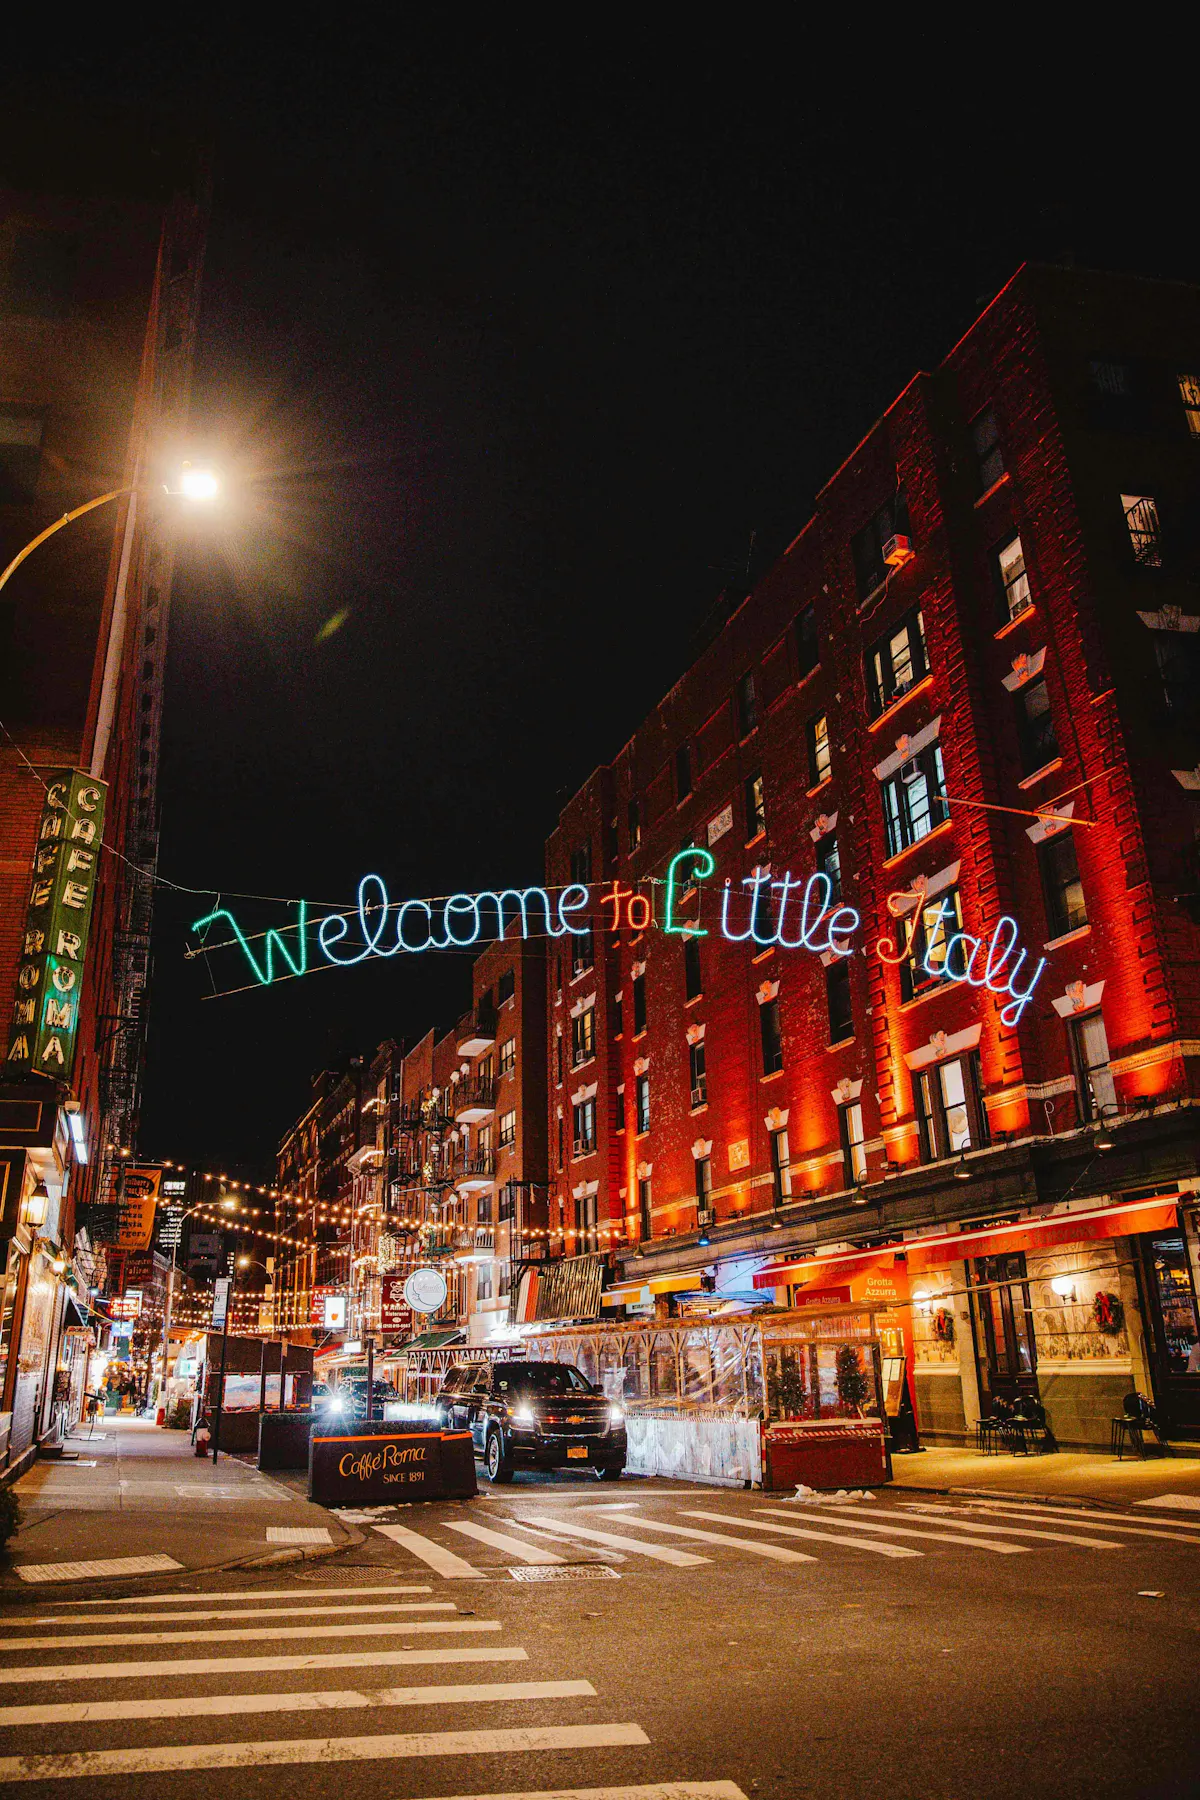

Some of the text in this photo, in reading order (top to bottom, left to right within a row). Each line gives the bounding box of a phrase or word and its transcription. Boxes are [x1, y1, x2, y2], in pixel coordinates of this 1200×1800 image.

[8, 783, 66, 1061] CAFE ROMA
[41, 786, 101, 1065] CAFE ROMA
[192, 849, 1046, 1027] Welcome to Little Italy
[866, 1277, 893, 1286] Grotta
[821, 1296, 841, 1304] Azzurra
[865, 1287, 897, 1296] Azzurra
[382, 1444, 427, 1469] Roma
[383, 1471, 425, 1484] SINCE 1891
